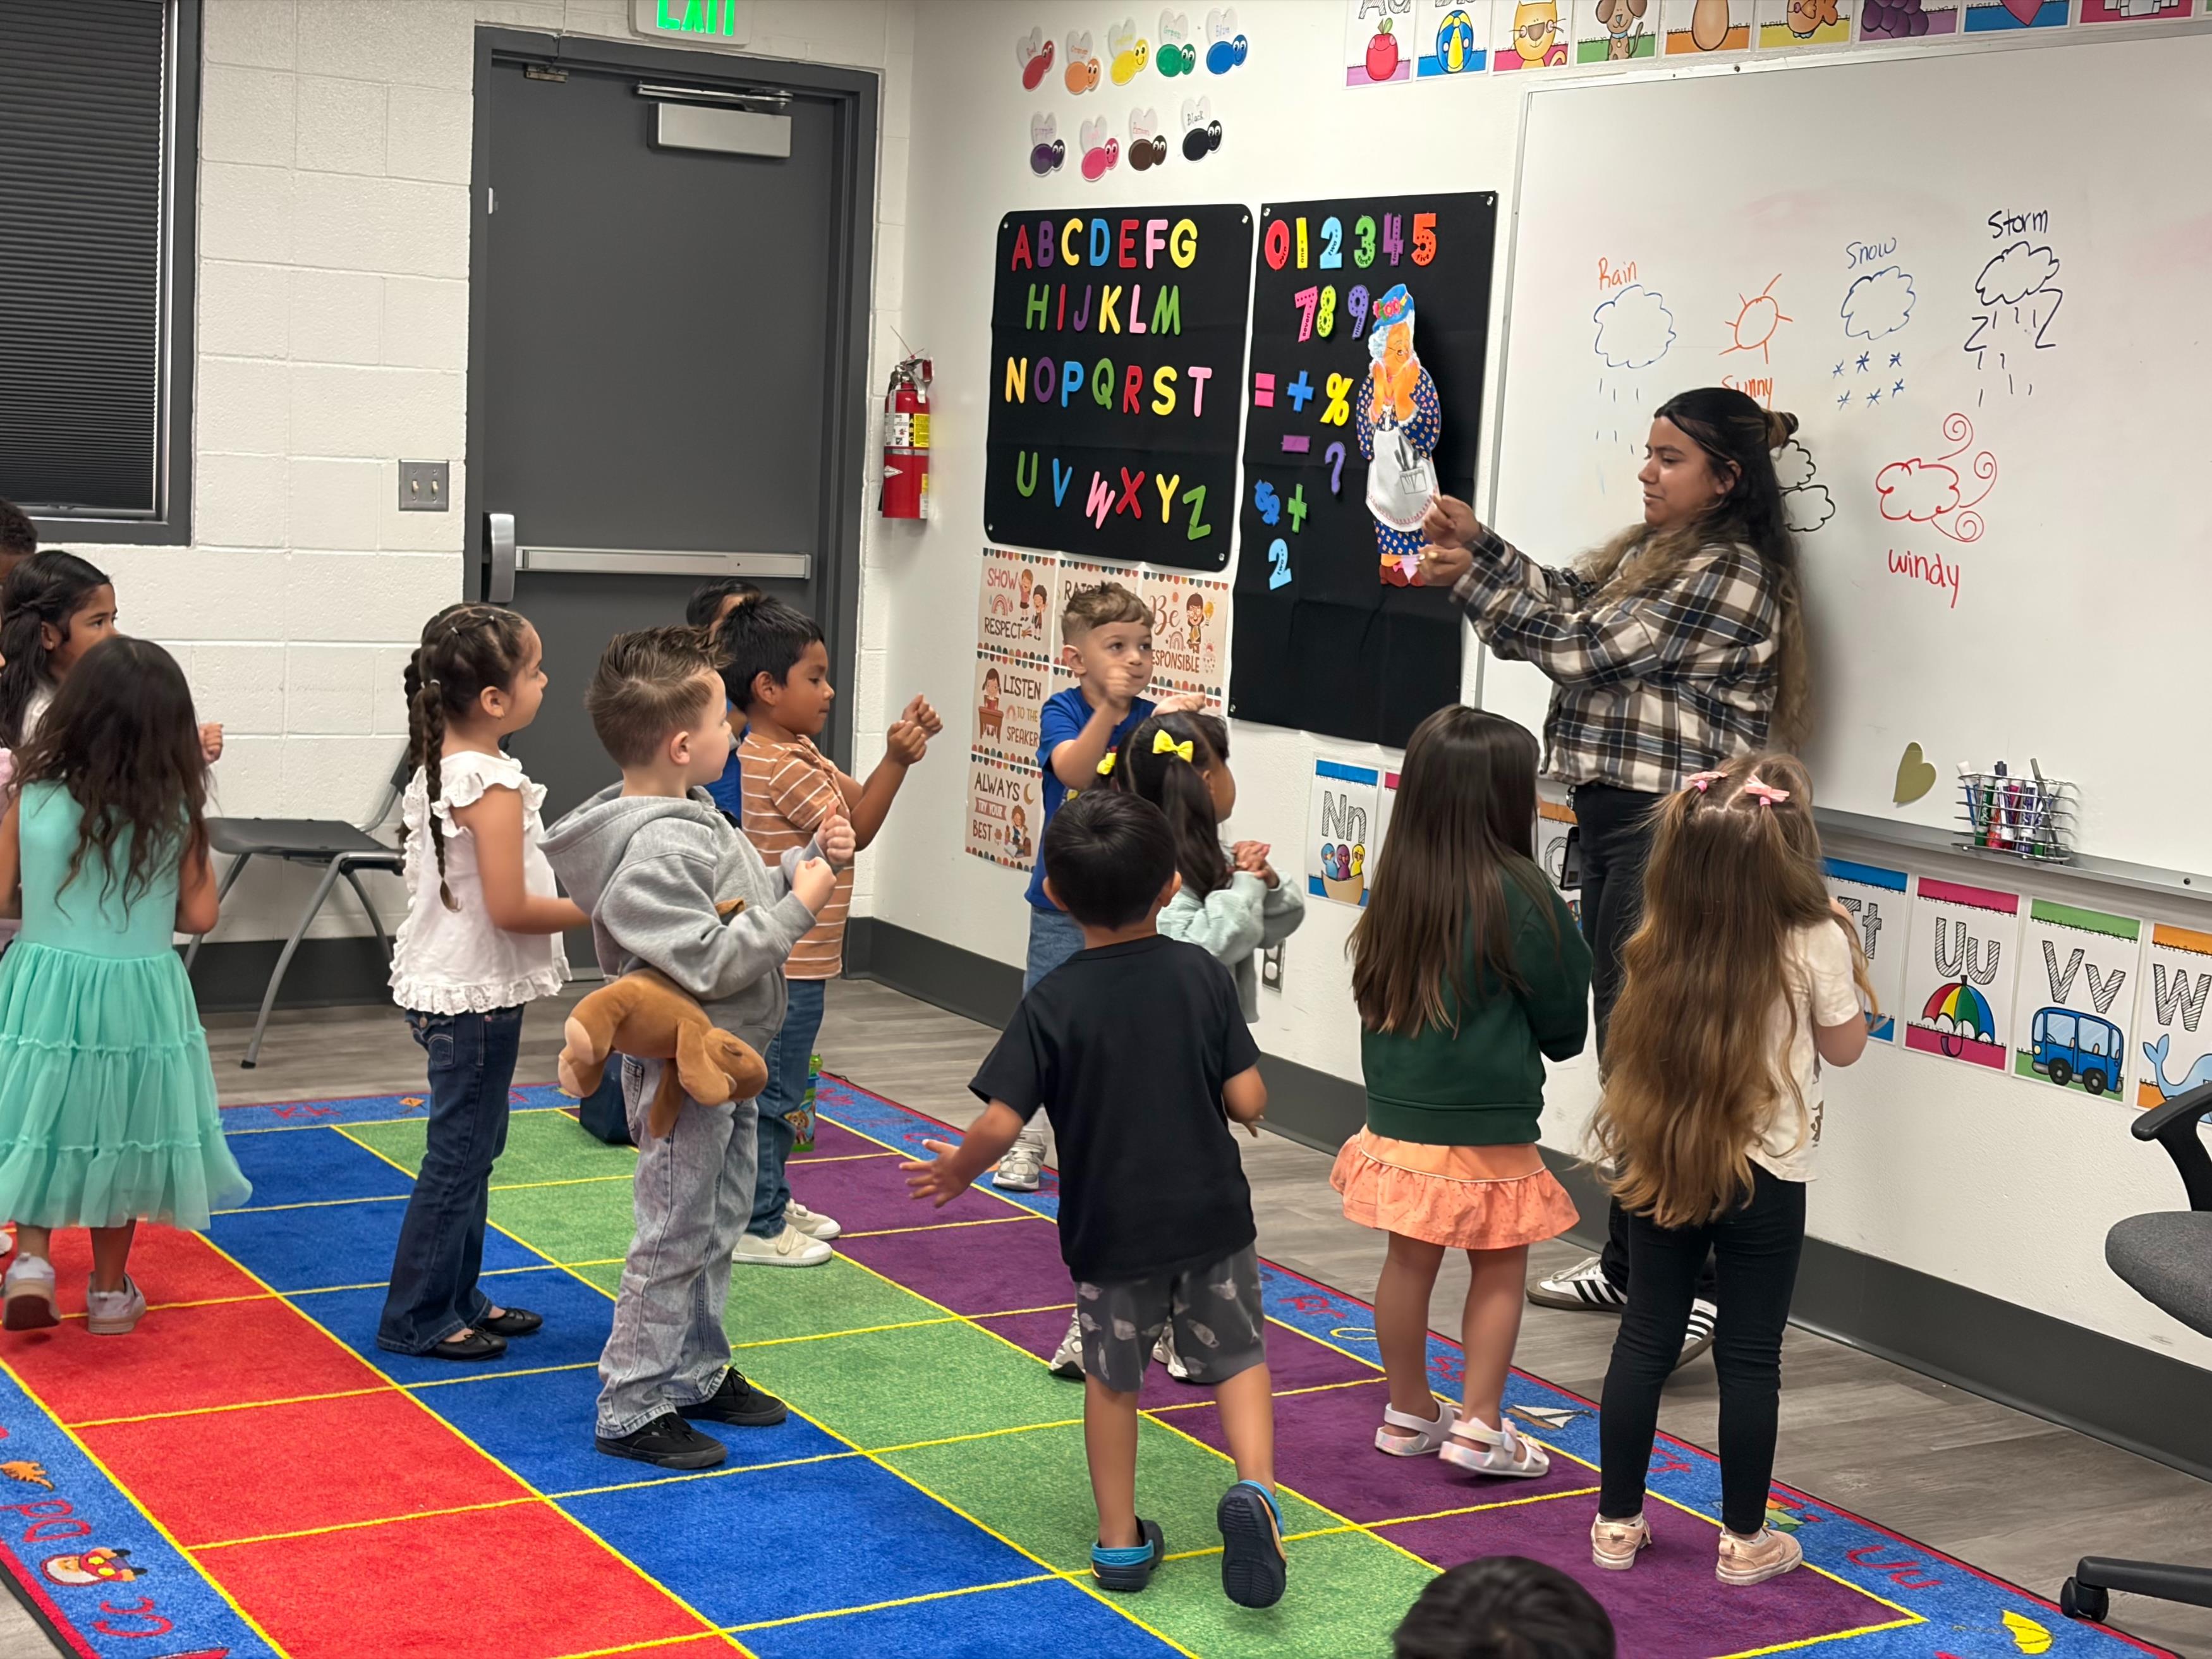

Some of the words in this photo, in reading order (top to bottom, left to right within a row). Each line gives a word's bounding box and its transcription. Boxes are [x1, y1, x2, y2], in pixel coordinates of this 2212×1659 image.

[1187, 111, 1203, 126] Black
[1988, 209, 2048, 239] Storm
[1846, 237, 1897, 269] Snow
[1598, 257, 1637, 290] Rain
[1302, 313, 1311, 336] seven
[1354, 317, 1363, 336] nine
[987, 568, 1018, 590] SHOW
[1150, 595, 1181, 636] Be
[985, 617, 1023, 640] RESPECT
[1152, 649, 1200, 673] ESPONSIBLE
[1004, 674, 1042, 701] LISTEN
[1017, 705, 1025, 720] TO
[1027, 708, 1038, 722] THE
[1006, 726, 1039, 748] SPEAKER
[975, 772, 1020, 802] ALWAYS
[1322, 790, 1366, 844] Nn
[973, 820, 992, 841] BEST
[1935, 917, 2001, 985] Uu
[2042, 940, 2126, 1014] Vv
